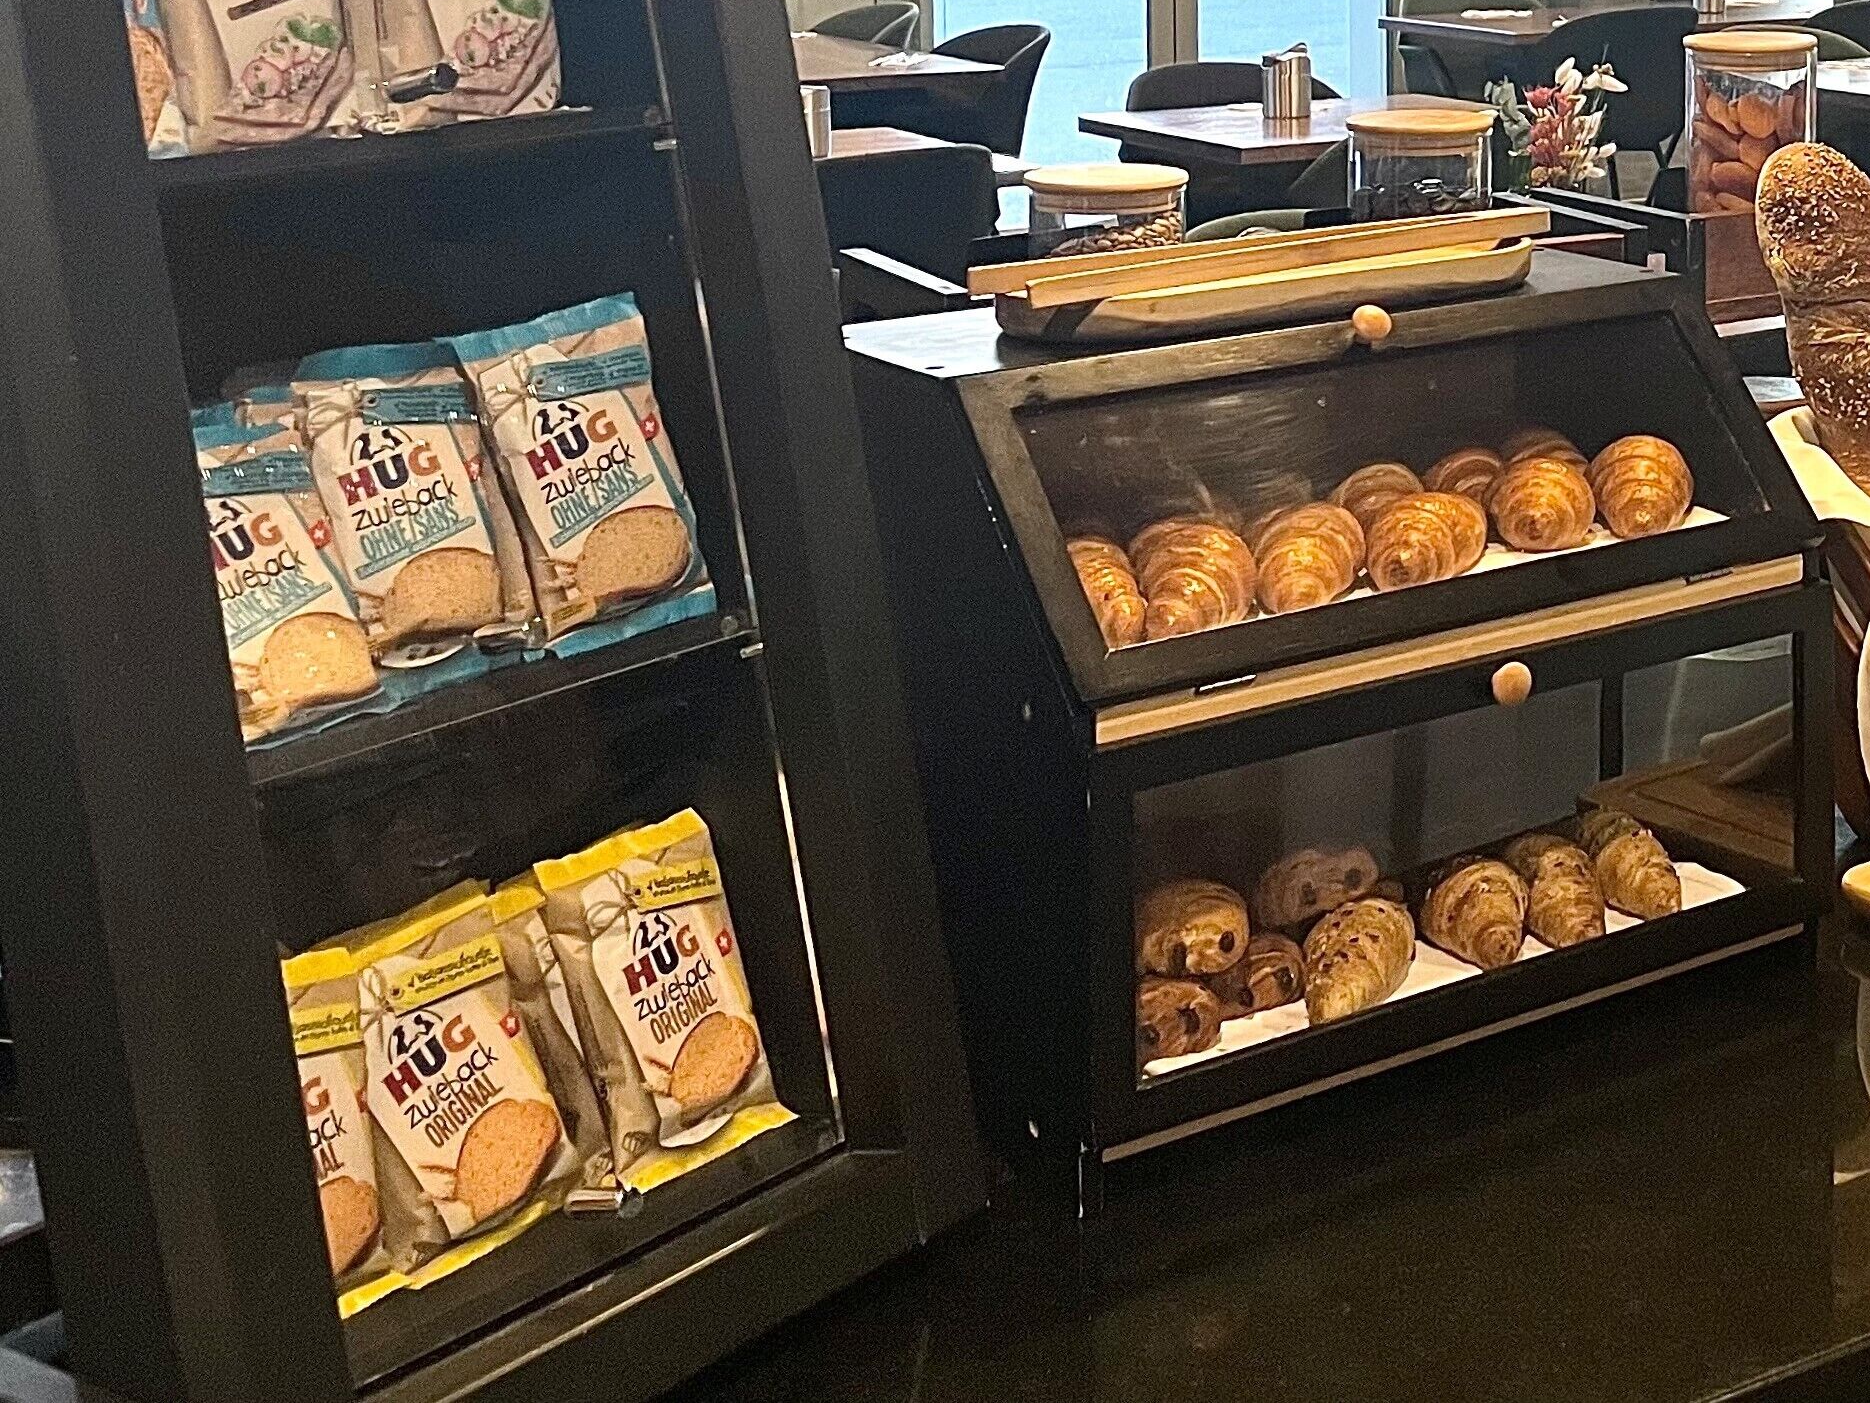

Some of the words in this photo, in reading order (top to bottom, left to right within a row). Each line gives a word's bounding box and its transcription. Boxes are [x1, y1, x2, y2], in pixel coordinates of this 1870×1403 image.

[337, 442, 442, 506] HUG
[525, 408, 619, 481] HUG
[540, 437, 636, 505] zwieback
[351, 473, 458, 532] zwieback
[219, 541, 309, 601] wieback
[622, 923, 700, 997] HUG
[633, 952, 716, 1022] zwieback
[649, 980, 718, 1045] ORIGINAL
[381, 1013, 477, 1108] HUG
[403, 1041, 499, 1130] zwieback
[424, 1071, 505, 1149] ORIGINAL
